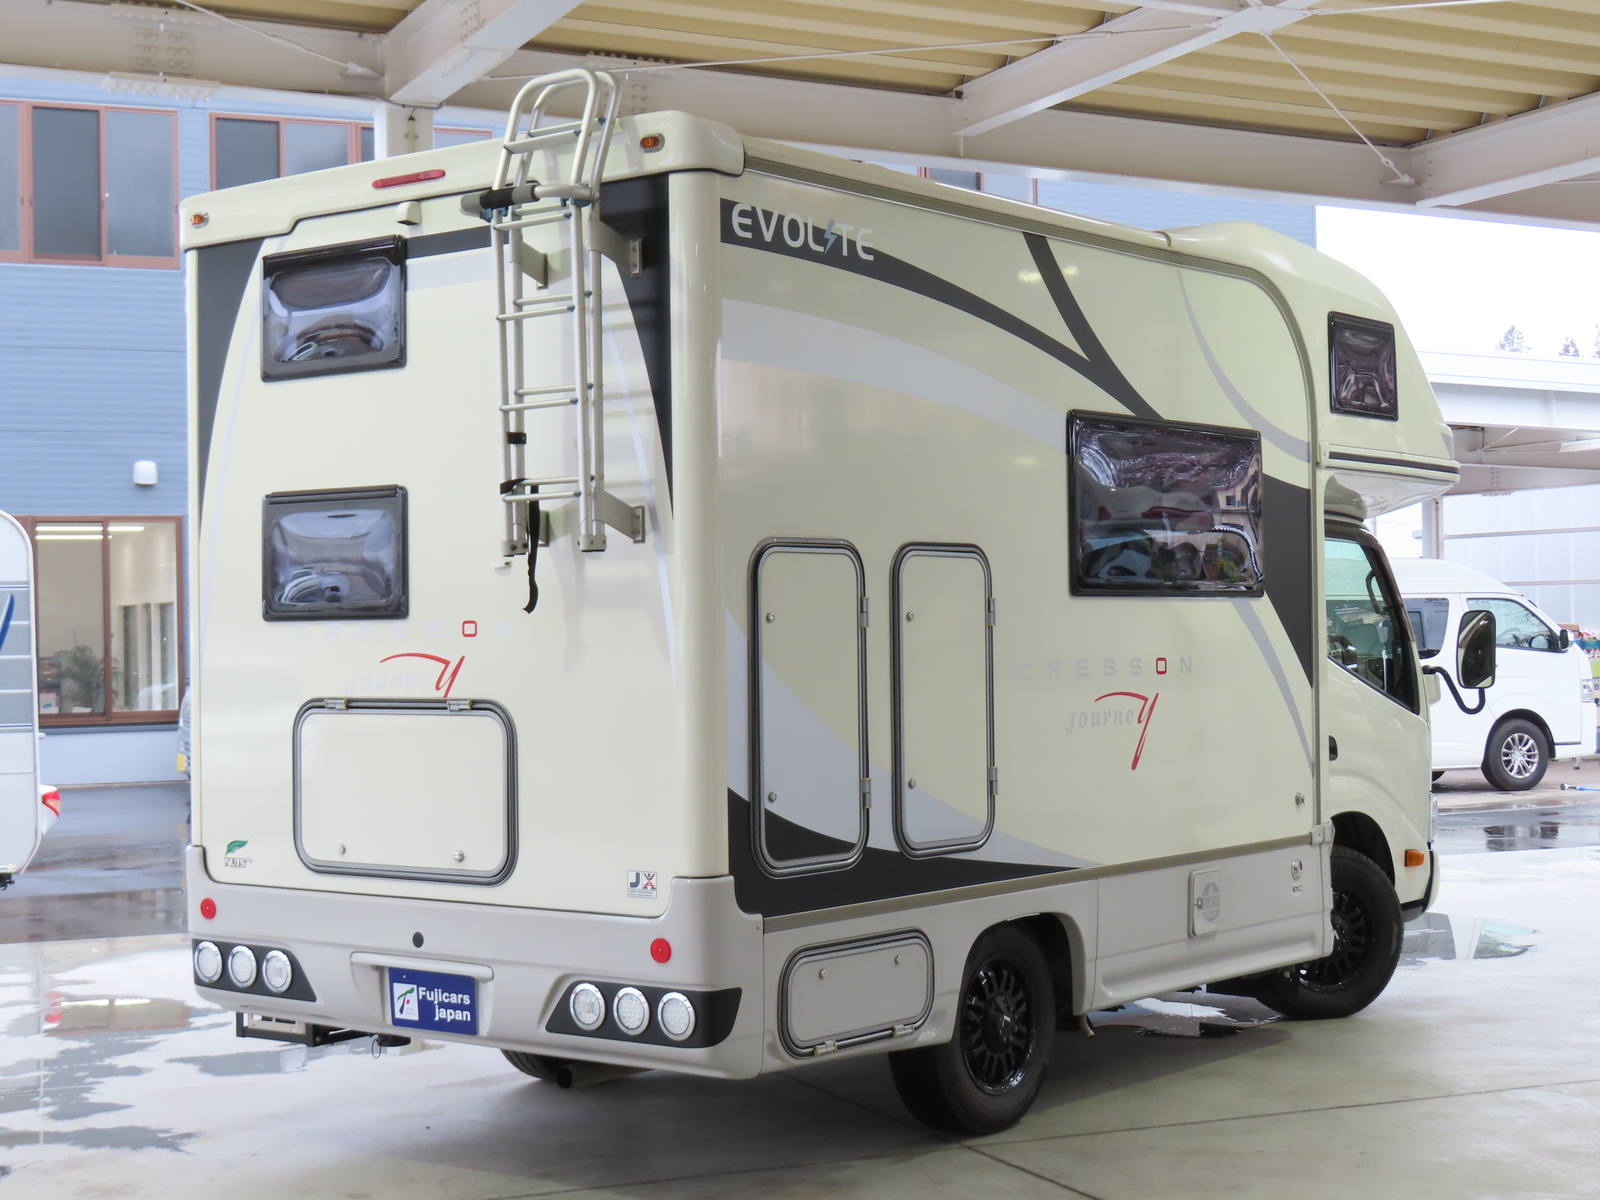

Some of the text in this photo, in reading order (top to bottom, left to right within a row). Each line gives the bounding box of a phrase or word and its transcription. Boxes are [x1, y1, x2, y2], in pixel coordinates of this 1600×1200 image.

[294, 620, 515, 640] CRESSON
[1018, 656, 1193, 682] CRESSON
[418, 986, 471, 1005] Fujicars
[434, 1004, 471, 1022] japan
